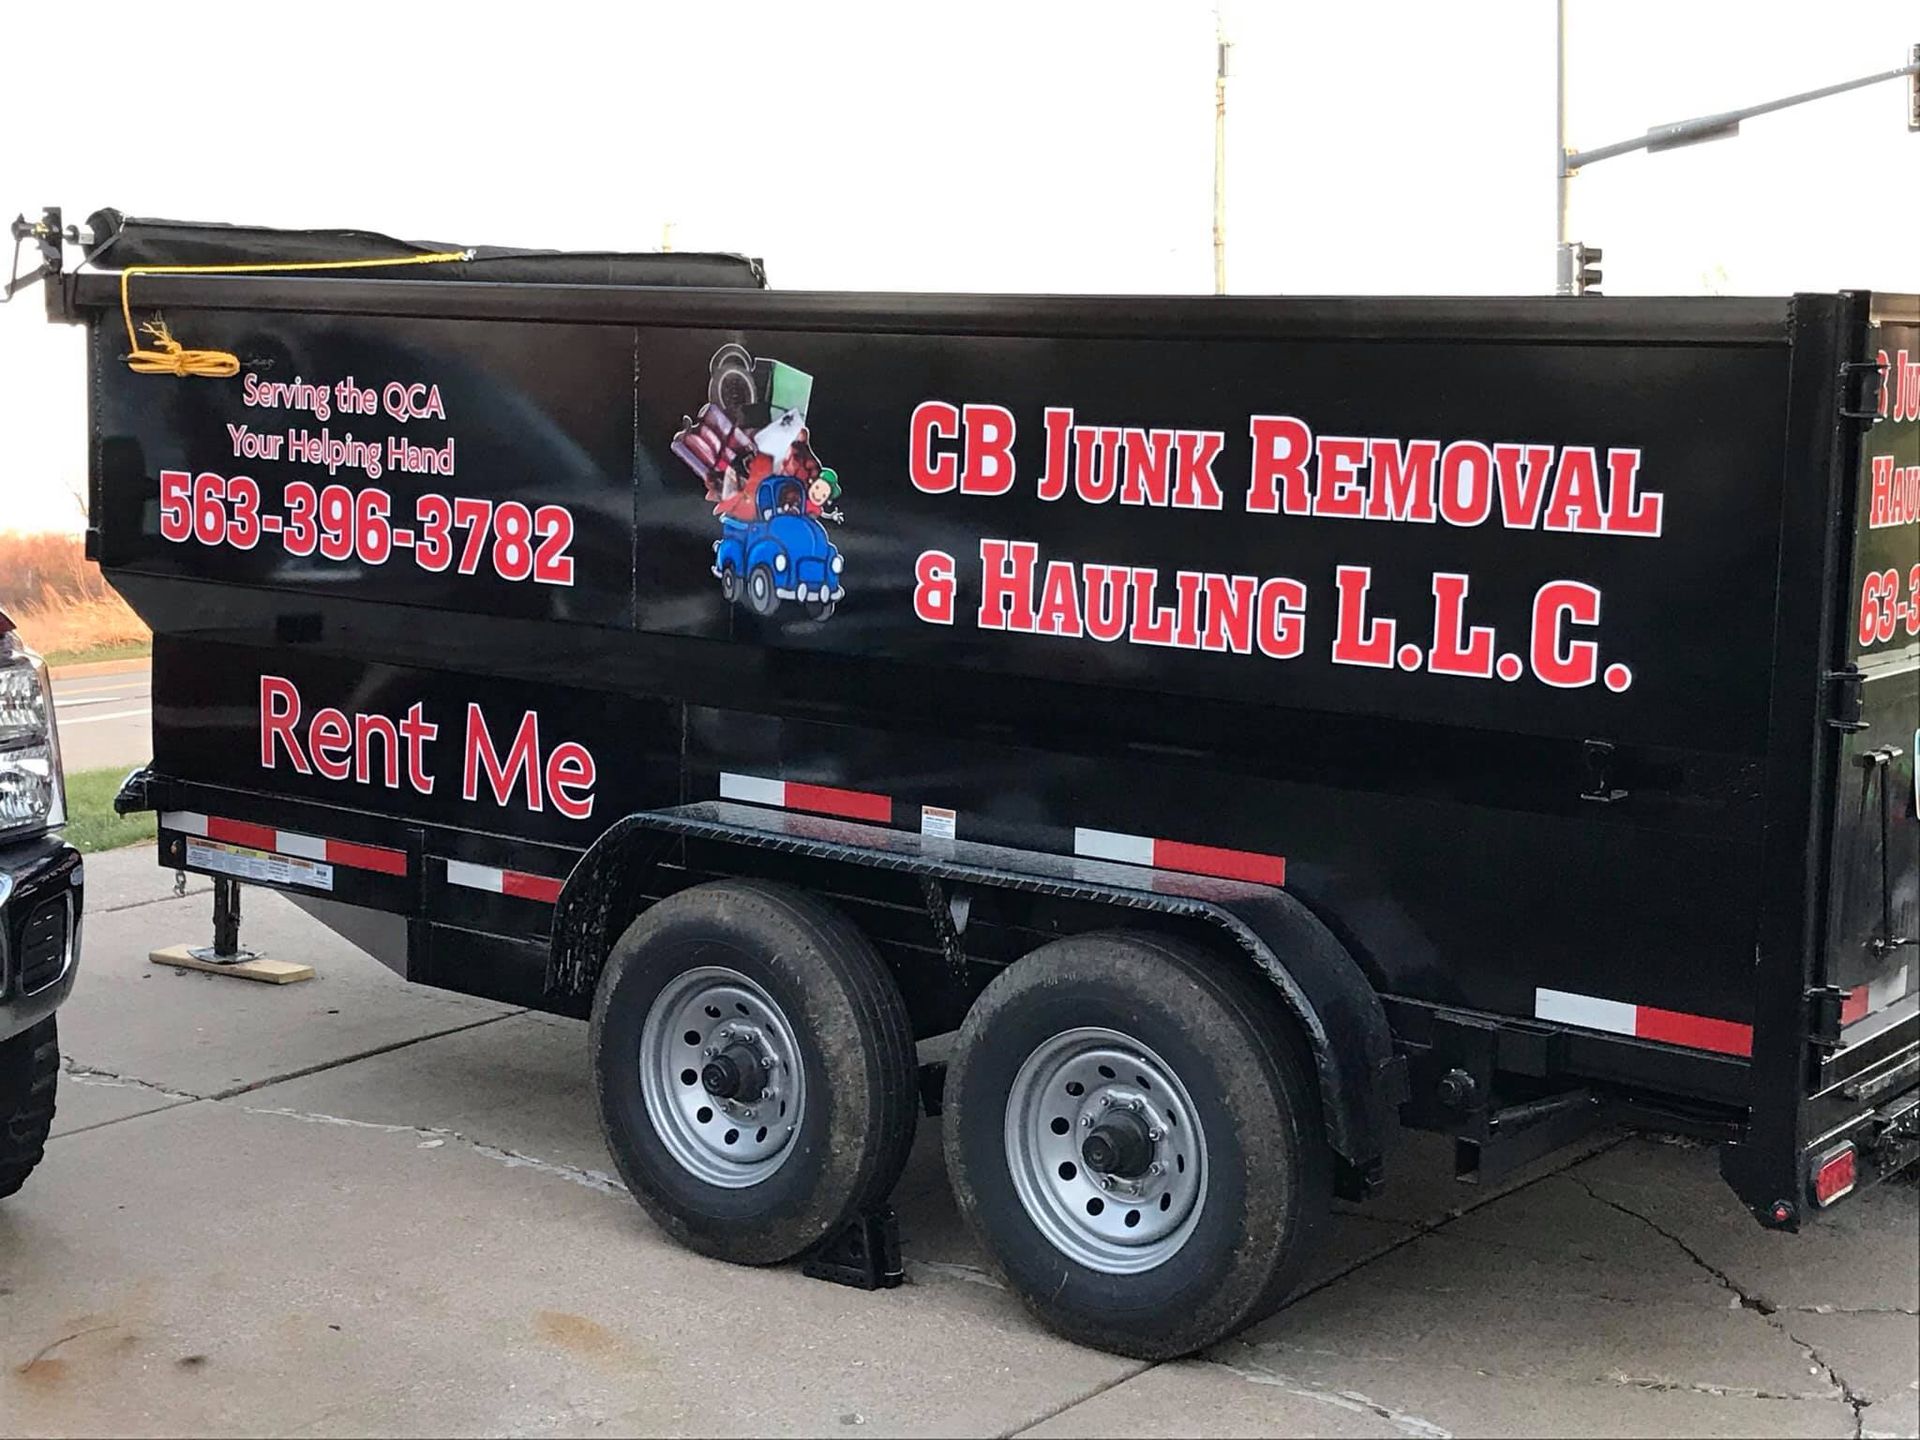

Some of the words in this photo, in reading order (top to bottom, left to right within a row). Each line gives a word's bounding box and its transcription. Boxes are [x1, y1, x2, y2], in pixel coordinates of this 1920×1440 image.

[243, 373, 330, 421] Serving
[334, 376, 377, 415] the
[383, 381, 446, 423] QCA
[1893, 350, 1920, 422] JU
[226, 423, 283, 459] Your
[288, 428, 382, 479] Helping
[387, 436, 455, 476] Hand
[909, 401, 1016, 496] CB
[160, 470, 574, 586] 563-396-3782
[1869, 456, 1920, 529] HAU
[913, 550, 957, 625] &
[1332, 565, 1632, 693] L.L.C.
[260, 675, 437, 795] Rent
[462, 702, 597, 820] Me
